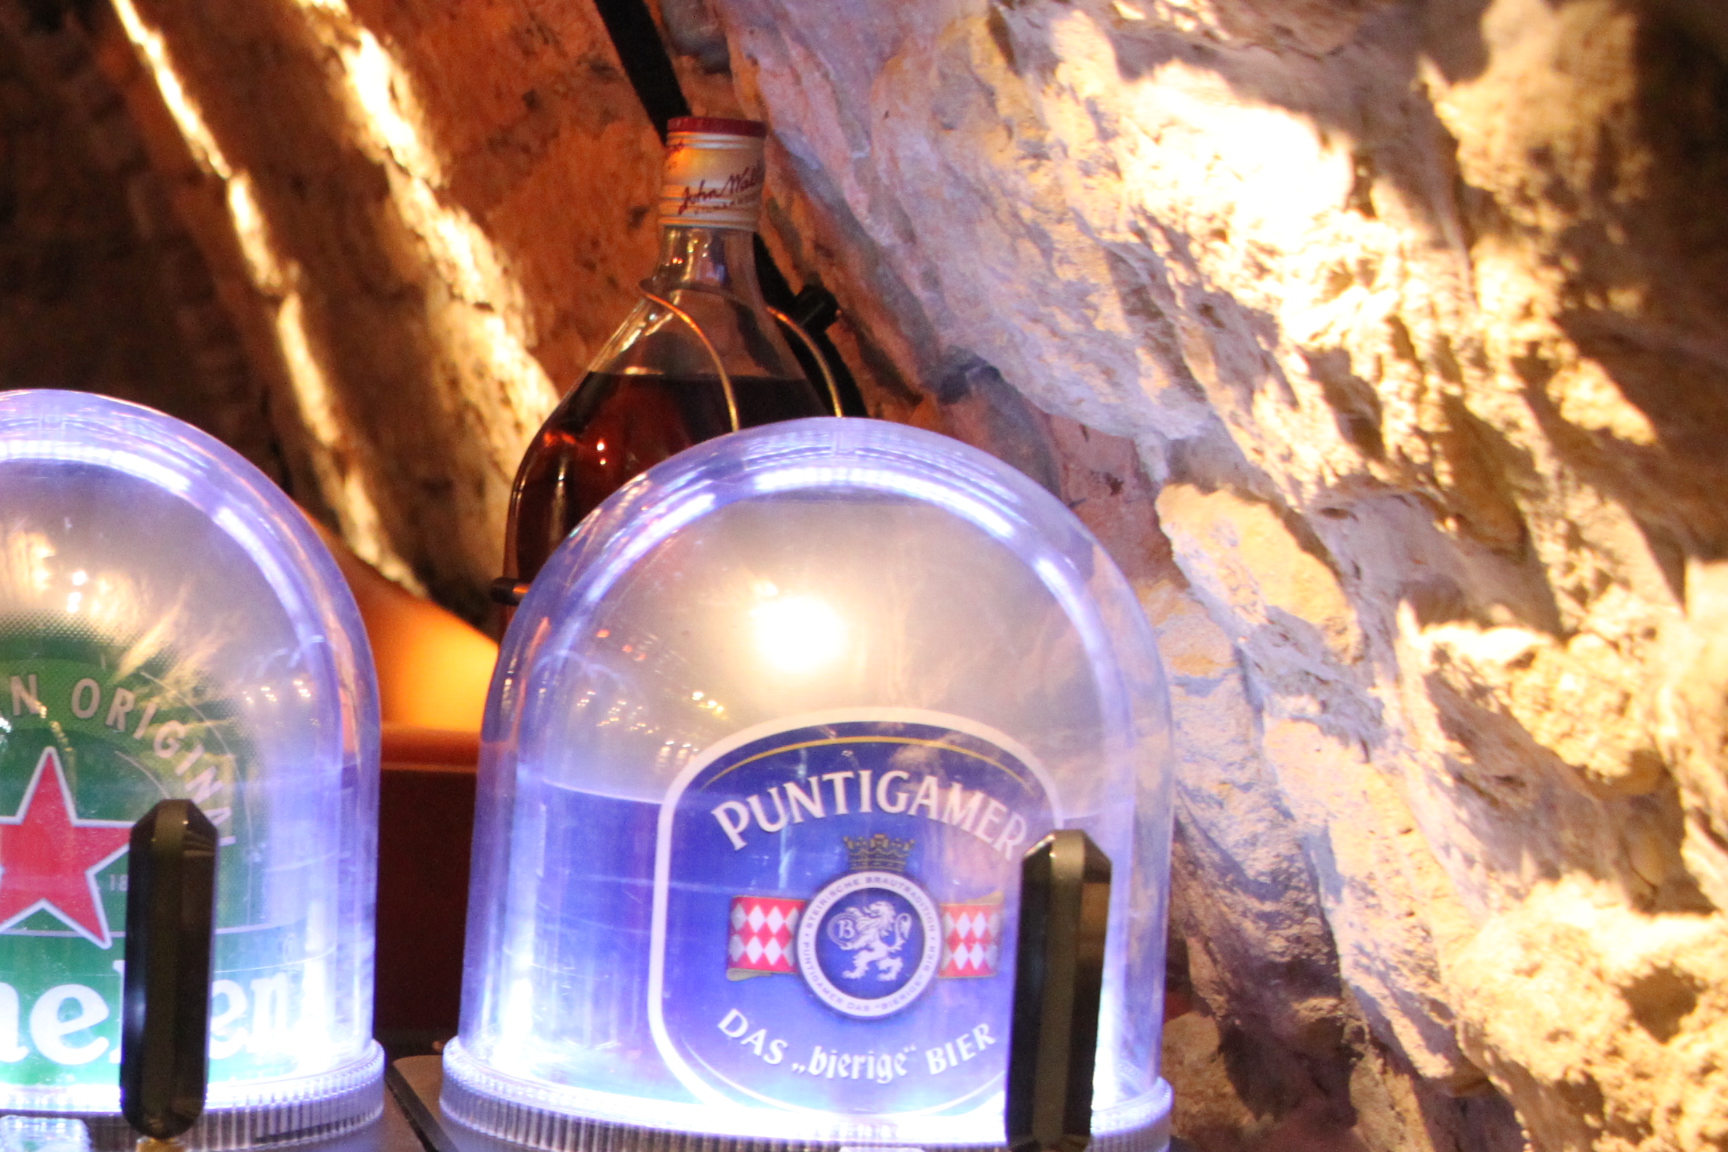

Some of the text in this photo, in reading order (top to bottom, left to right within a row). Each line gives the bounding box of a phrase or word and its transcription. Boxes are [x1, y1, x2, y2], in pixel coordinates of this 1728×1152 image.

[710, 769, 1028, 862] PUNTIGAMER
[109, 874, 129, 893] 18
[717, 1008, 790, 1065] DAS
[925, 1022, 998, 1076] BIER
